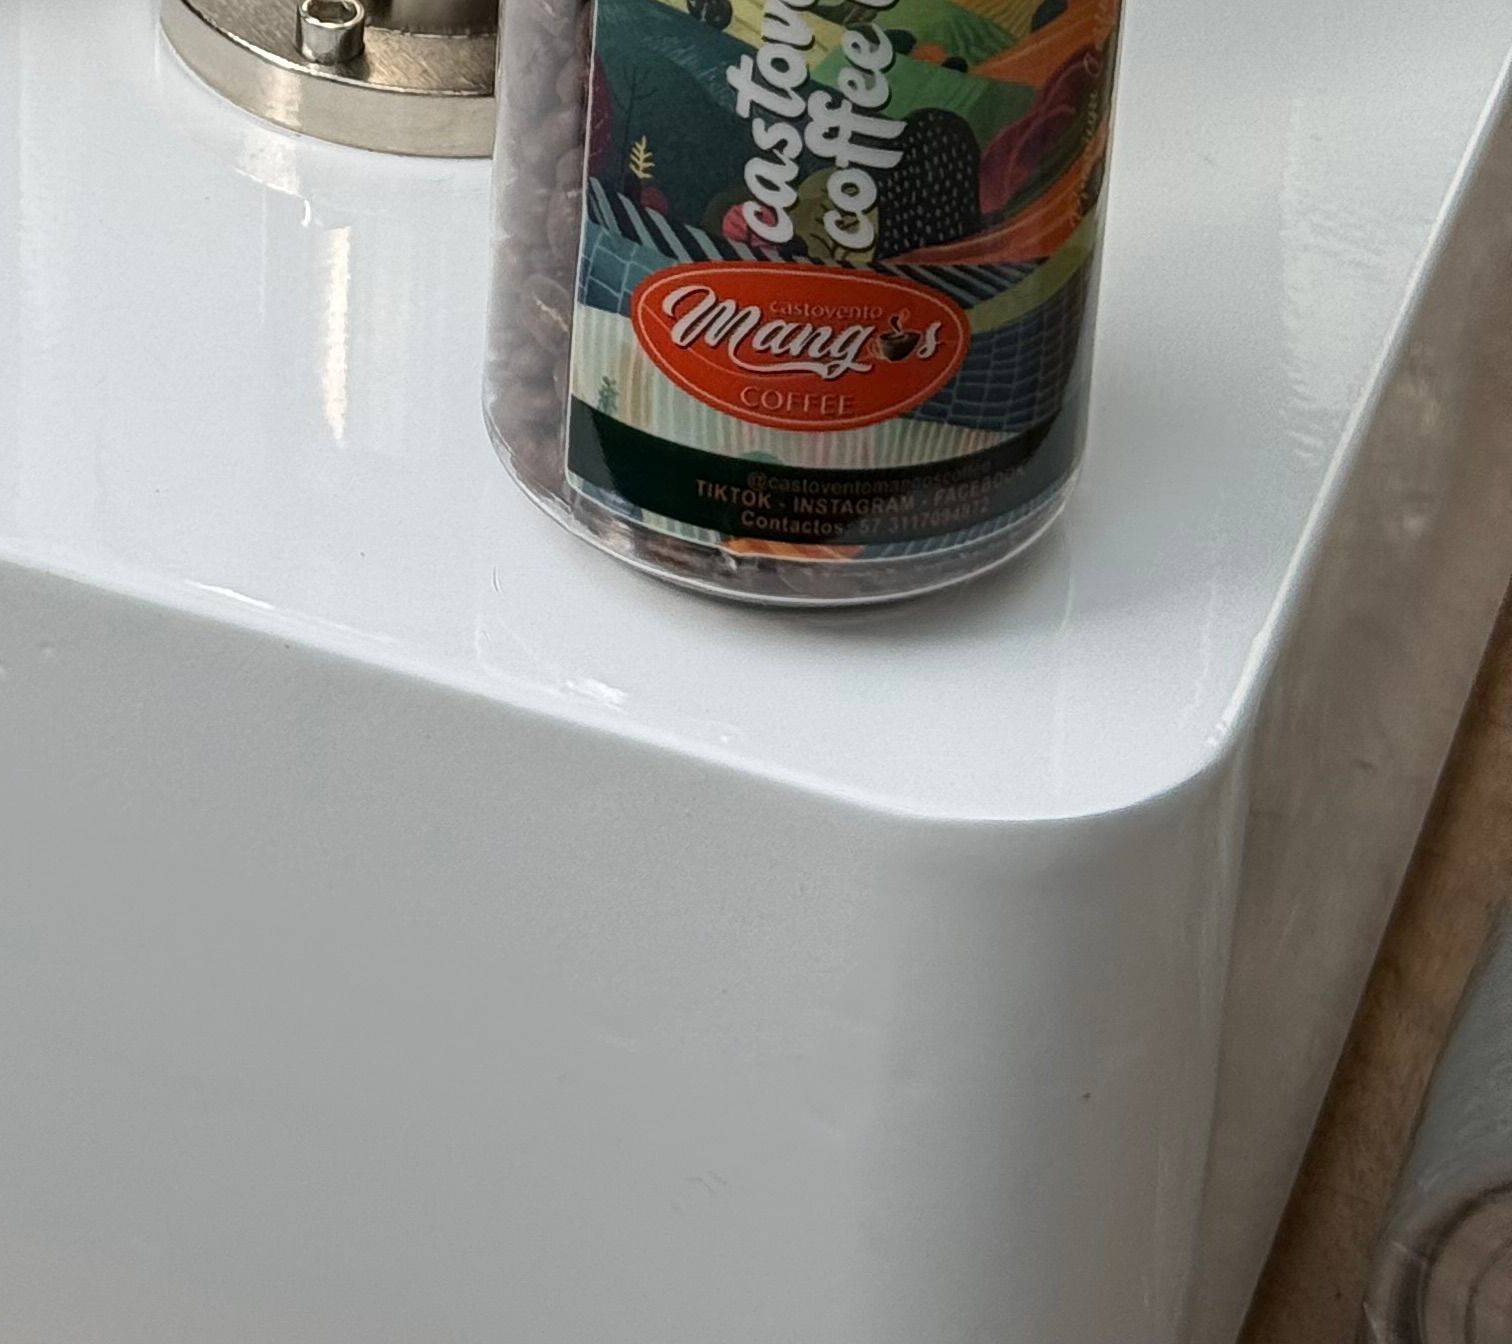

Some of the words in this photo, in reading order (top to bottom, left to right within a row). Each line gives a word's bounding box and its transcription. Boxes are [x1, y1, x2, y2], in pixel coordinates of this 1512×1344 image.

[804, 21, 908, 249] coffee
[768, 299, 884, 319] castovento
[739, 386, 856, 417] COFFEE
[696, 478, 772, 510] TIKTOK
[792, 495, 915, 515] INSTAGRAM
[859, 518, 879, 534] 57
